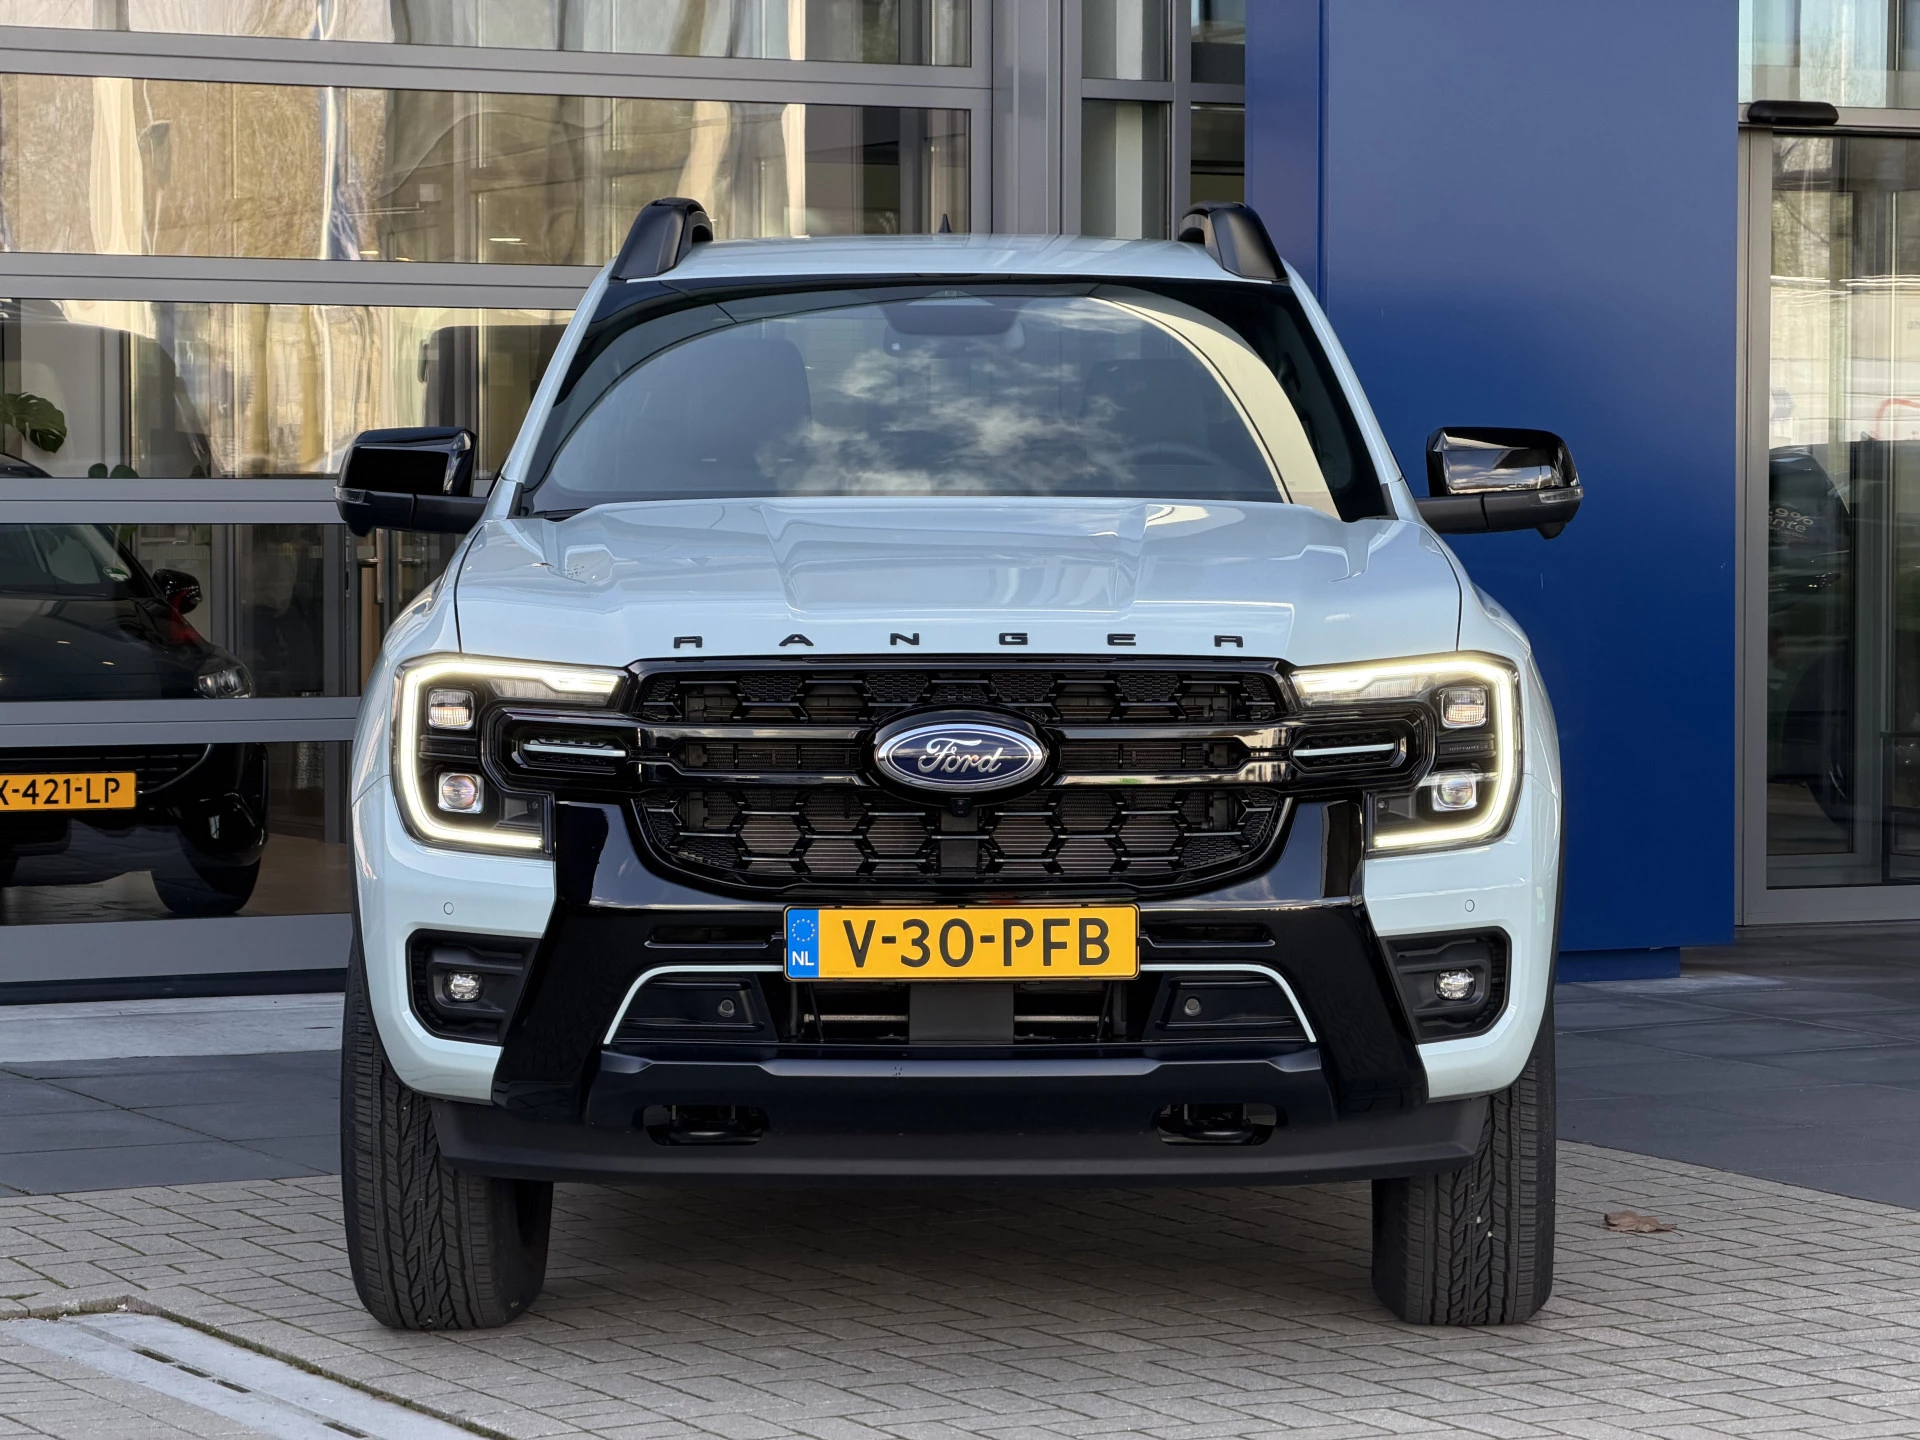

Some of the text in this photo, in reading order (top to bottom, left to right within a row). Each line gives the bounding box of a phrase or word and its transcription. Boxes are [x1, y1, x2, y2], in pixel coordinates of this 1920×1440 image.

[1768, 506, 1814, 526] .9%
[673, 632, 1244, 649] RANGER
[918, 737, 1004, 773] Ford
[842, 917, 1111, 968] V-30-PFB
[791, 950, 815, 966] NL
